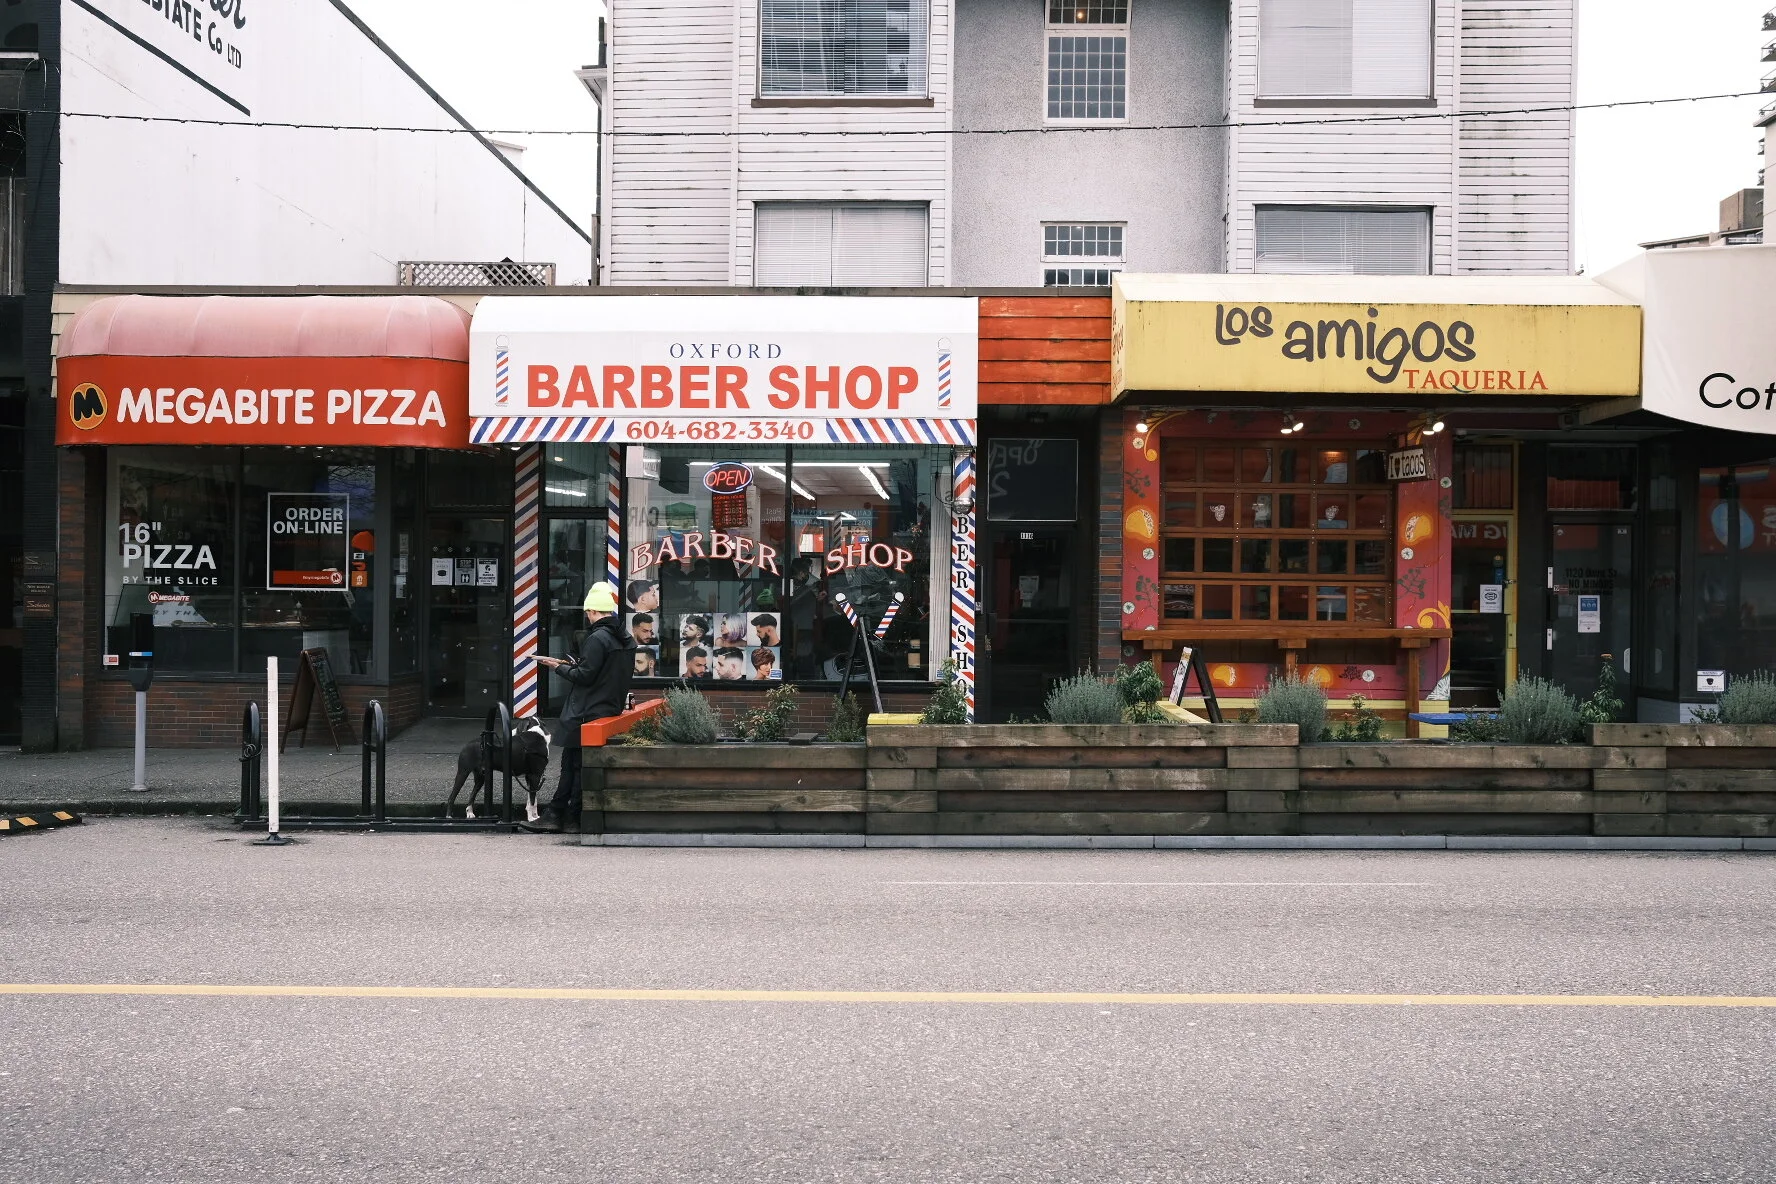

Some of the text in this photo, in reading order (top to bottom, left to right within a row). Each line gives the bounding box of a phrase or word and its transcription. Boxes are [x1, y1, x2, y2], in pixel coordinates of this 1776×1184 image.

[208, 22, 222, 54] Co
[228, 43, 241, 69] LTD
[670, 342, 781, 359] OXFORD
[1281, 307, 1476, 382] amigos
[527, 365, 919, 409] BARBER SHOP
[1403, 369, 1548, 392] TAQUERIA
[117, 387, 314, 425] MEGABITE
[327, 389, 447, 427] PIZZA
[626, 421, 814, 440] 604-682-3340
[1402, 450, 1425, 477] tacos
[705, 469, 748, 486] OPEN
[285, 507, 344, 521] ORDER
[119, 521, 161, 543] 16"
[273, 521, 343, 534] ON-LINE
[123, 544, 217, 569] PIZZA
[631, 531, 914, 576] BARBER SHOP
[122, 576, 218, 585] BY THE SLICE
[159, 594, 191, 602] MEGABITE
